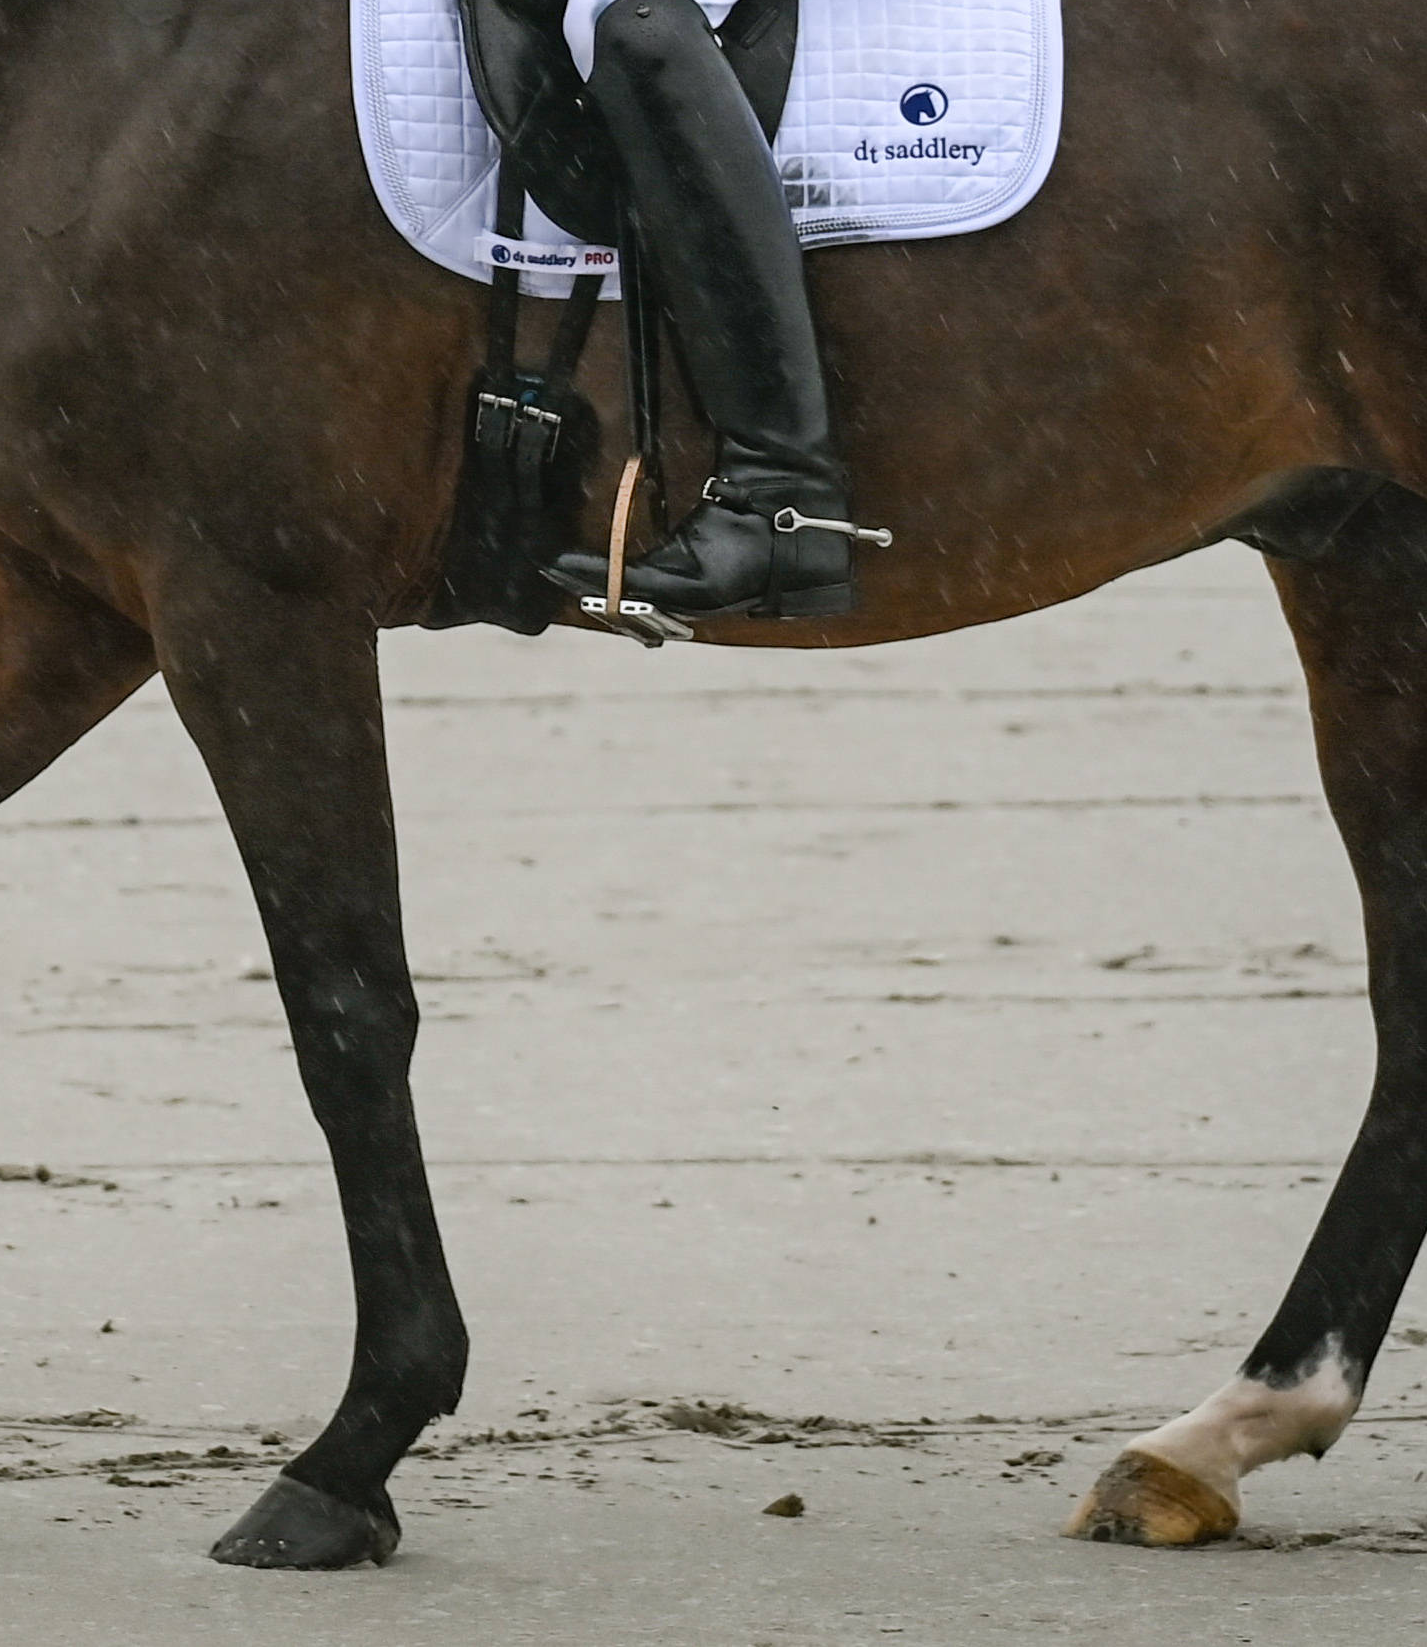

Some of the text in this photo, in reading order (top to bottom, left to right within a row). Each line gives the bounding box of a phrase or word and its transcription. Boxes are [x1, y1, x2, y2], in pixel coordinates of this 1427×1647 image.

[854, 137, 986, 166] dt saddlery
[584, 252, 615, 266] PRO
